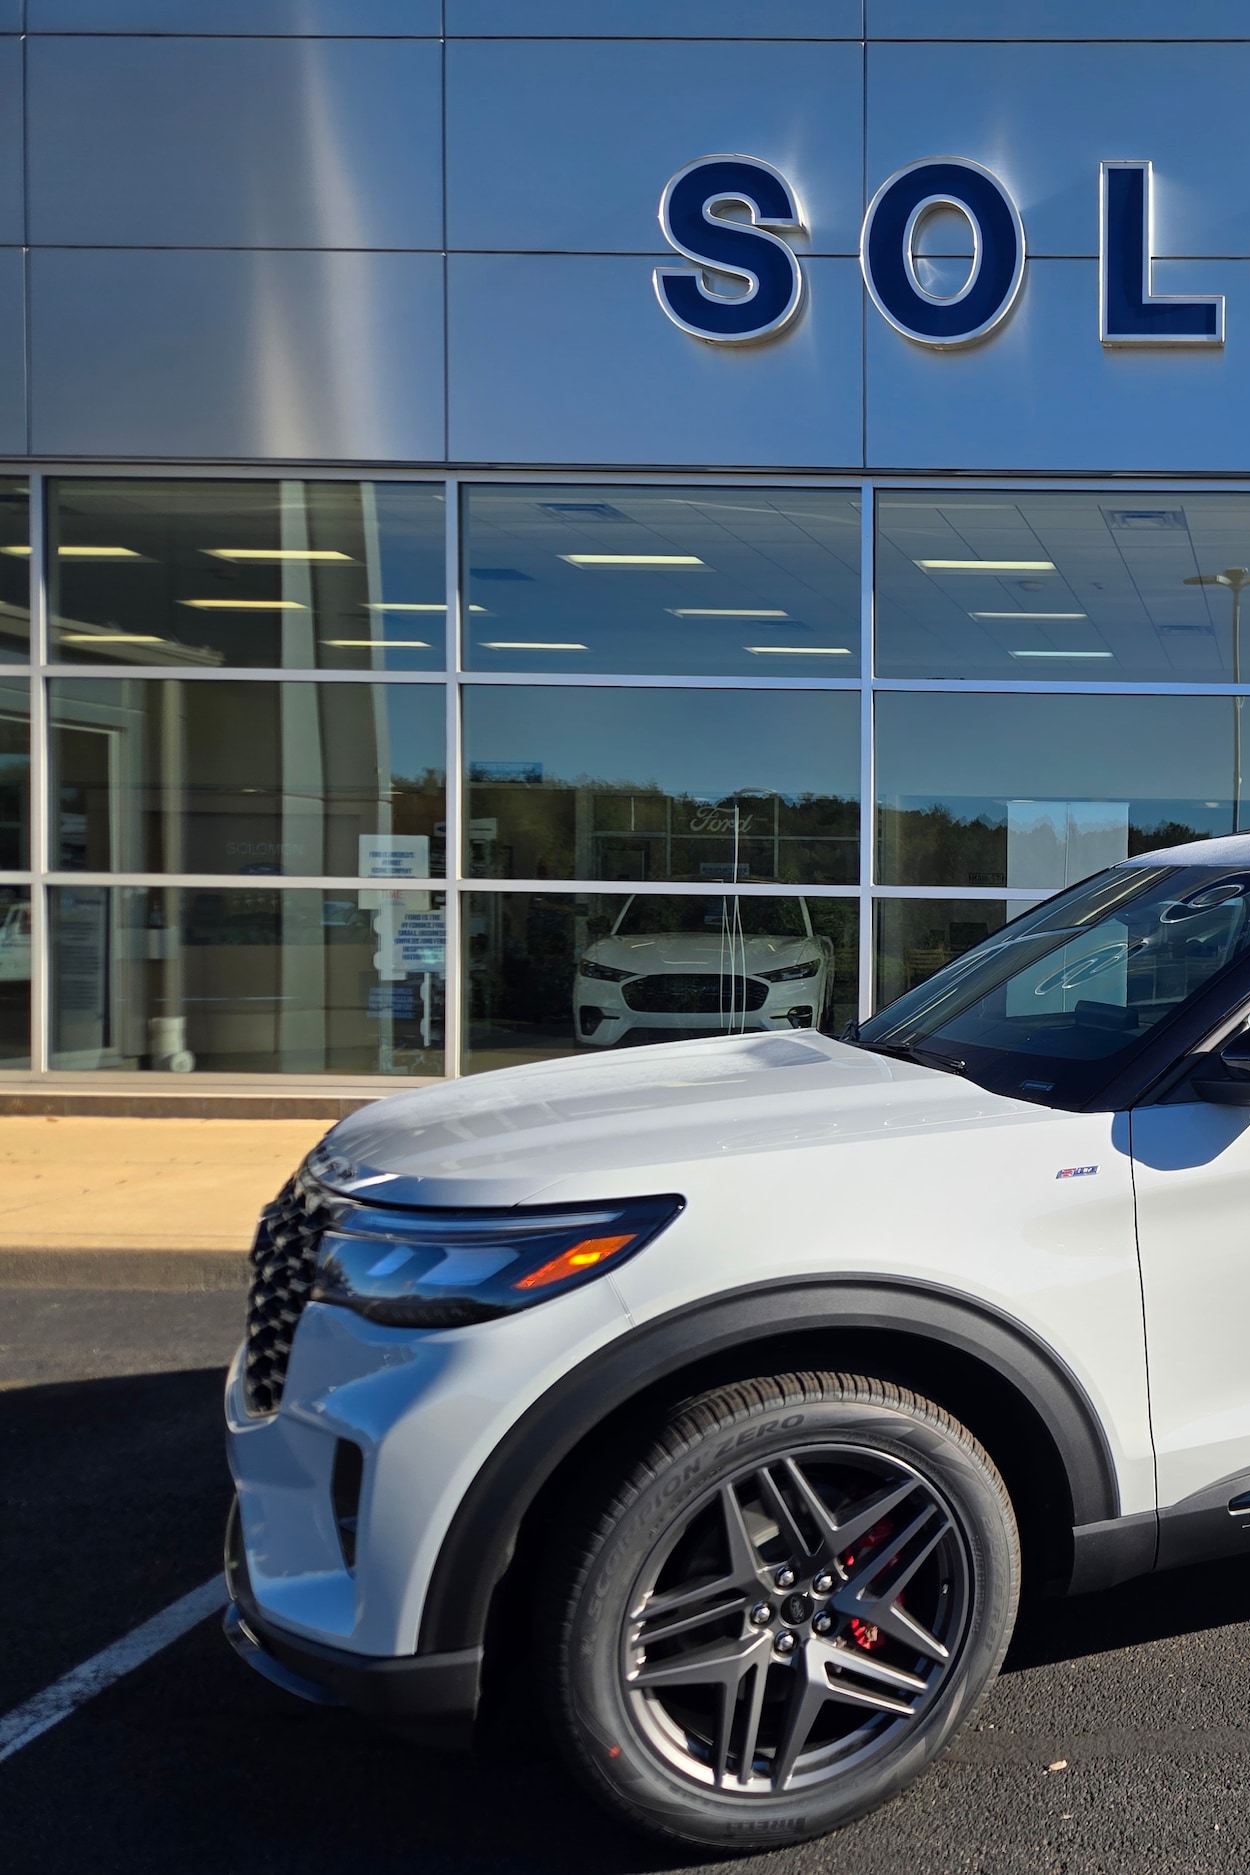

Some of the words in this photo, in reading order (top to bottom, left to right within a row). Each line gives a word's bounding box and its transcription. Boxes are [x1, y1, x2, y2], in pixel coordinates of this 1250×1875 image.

[690, 806, 753, 833] Ford
[225, 841, 305, 856] SOLOMON
[587, 1456, 702, 1621] SCORPION
[714, 1413, 806, 1460] ZERO
